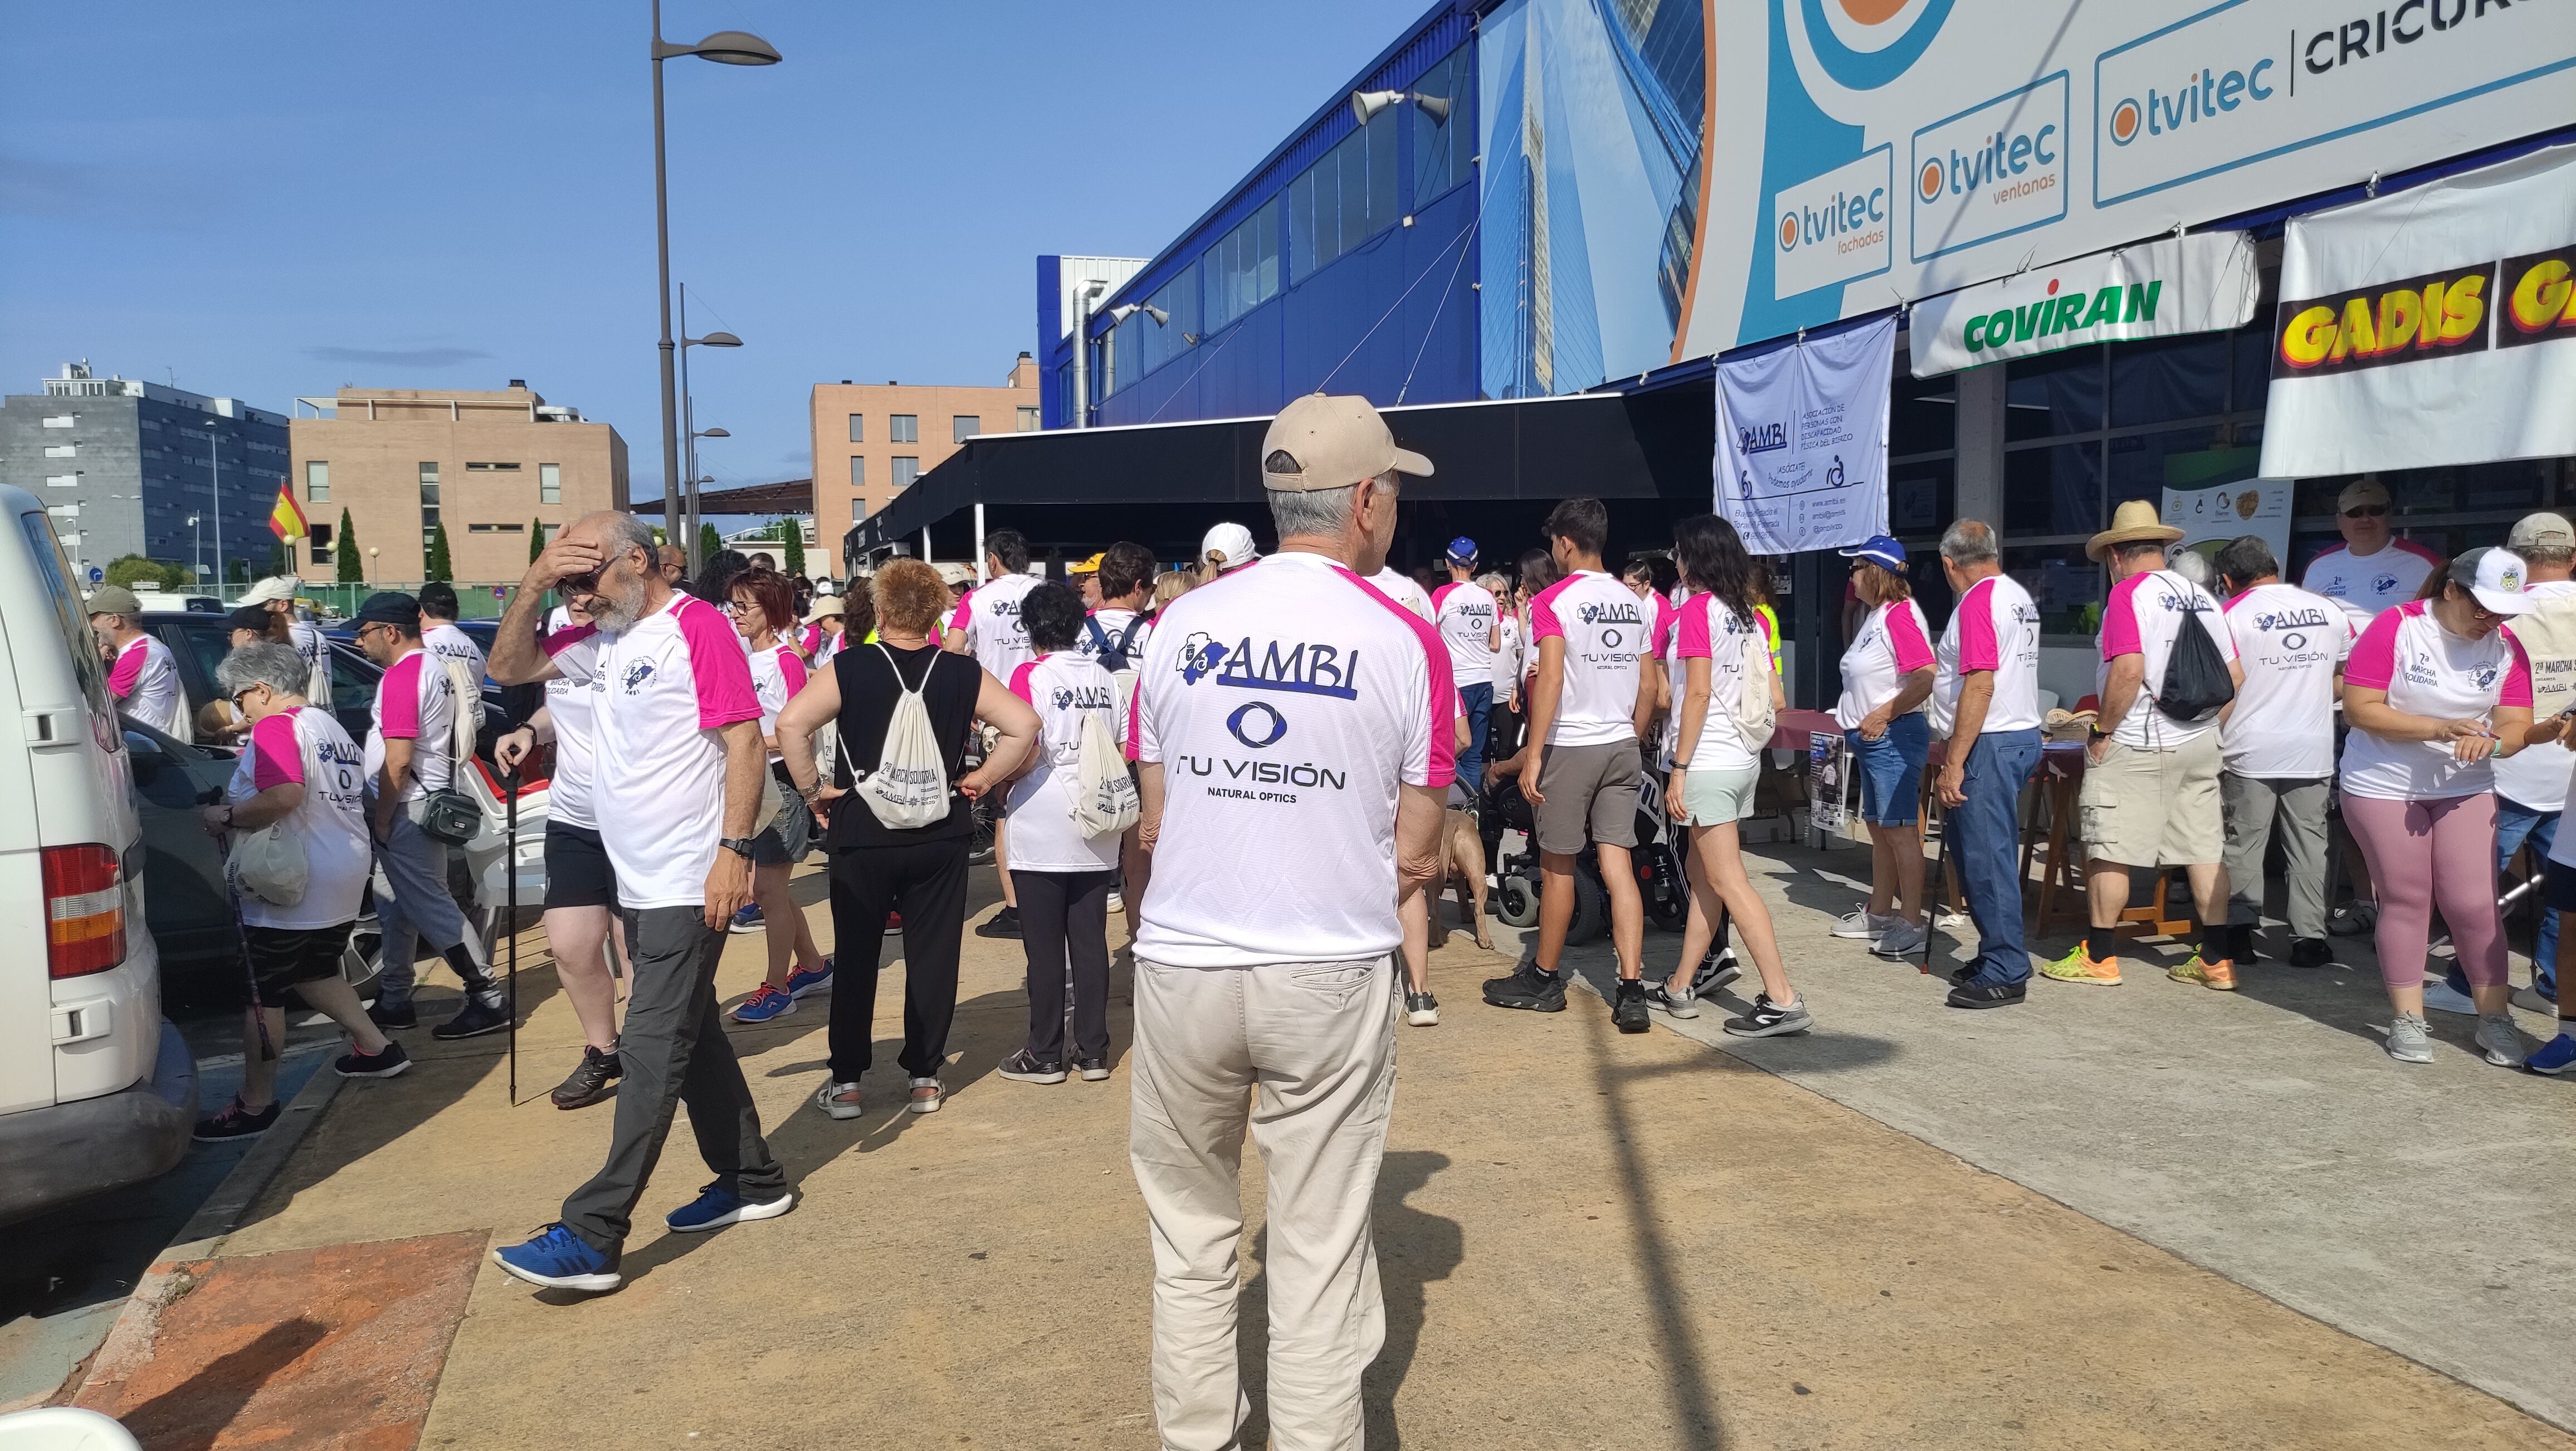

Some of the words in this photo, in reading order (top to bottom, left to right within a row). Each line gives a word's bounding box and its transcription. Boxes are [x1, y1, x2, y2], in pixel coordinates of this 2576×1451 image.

[2149, 59, 2273, 136] tvitec
[1949, 124, 2055, 195] tvitec
[1993, 173, 2055, 205] ventanas
[1804, 186, 1884, 245] tvitec
[1837, 230, 1884, 256] fachadas
[2280, 275, 2485, 369] GADIS
[1802, 405, 1836, 419] ASOCIACIÓN
[1837, 403, 1845, 412] DE
[1801, 420, 1828, 430] PERSONAS
[1829, 415, 1843, 424] CON
[1749, 422, 1787, 451] AMBI
[1801, 426, 1842, 441] DISCAPACIDAD
[1819, 439, 1830, 447] DEL
[1470, 603, 1491, 615] AMBI
[1598, 603, 1641, 623] AMBI
[2276, 609, 2328, 628] AMBI
[1126, 640, 1143, 656] BI
[1581, 654, 1598, 663] TU
[1601, 652, 1639, 662] VISIÓN
[2259, 657, 2279, 665] TU
[2283, 651, 2328, 663] VISIÓN
[2419, 653, 2429, 665] 2ª
[1219, 637, 1358, 697] AMBI
[1722, 664, 1739, 673] TU
[2410, 665, 2436, 678] MARCHA
[2545, 660, 2572, 673] MARCHA
[2405, 673, 2438, 687] SOLIDARIA
[2544, 683, 2567, 692] AMBI
[1075, 686, 1111, 708] AMBI
[1060, 742, 1079, 751] TU
[1222, 758, 1345, 790] VISIÓN
[881, 791, 905, 804] AMBI
[1208, 787, 1256, 801] NATURAL
[1259, 791, 1296, 804] OPTICS
